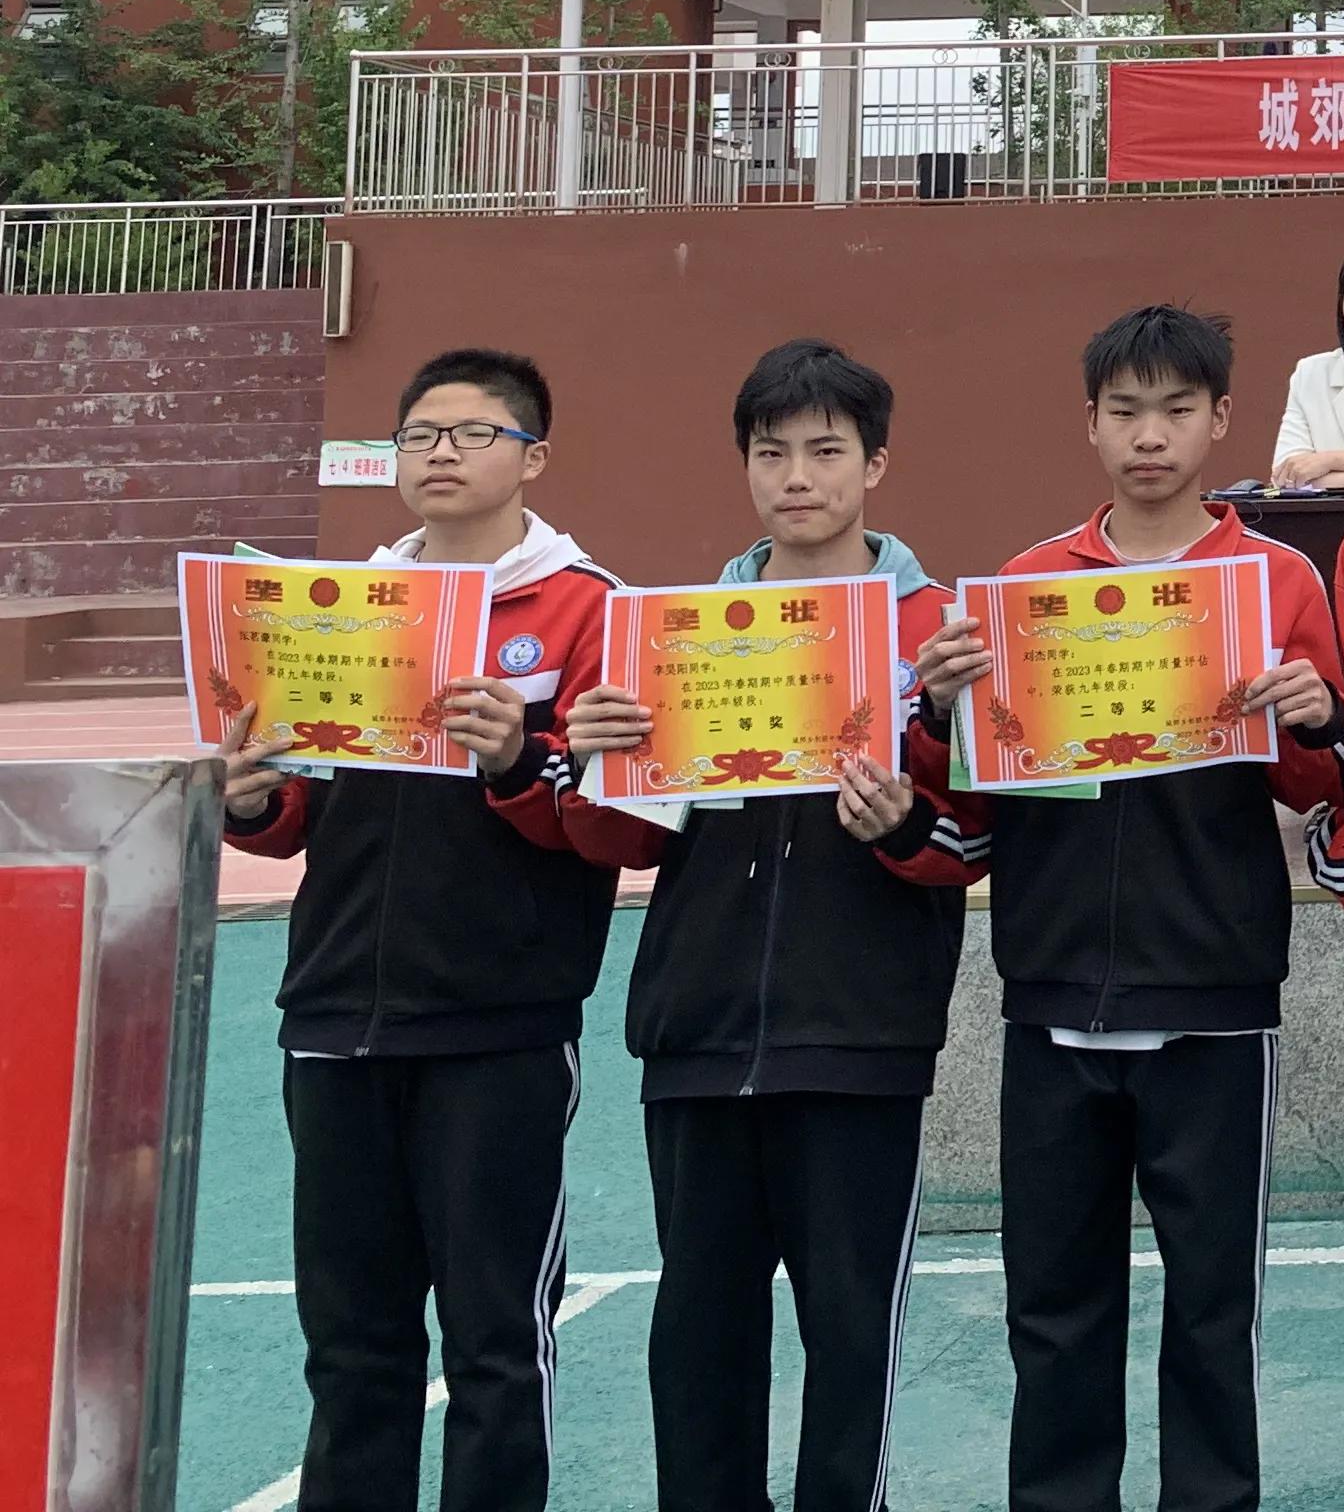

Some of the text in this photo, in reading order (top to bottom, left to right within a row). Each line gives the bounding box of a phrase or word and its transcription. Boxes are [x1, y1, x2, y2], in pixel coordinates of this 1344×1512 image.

[367, 582, 409, 606] 状
[1152, 581, 1193, 608] 状
[780, 599, 819, 624] 状
[288, 690, 363, 706] 二等奖
[1080, 699, 1156, 718] 二等奖
[708, 715, 784, 733] 二等奖
